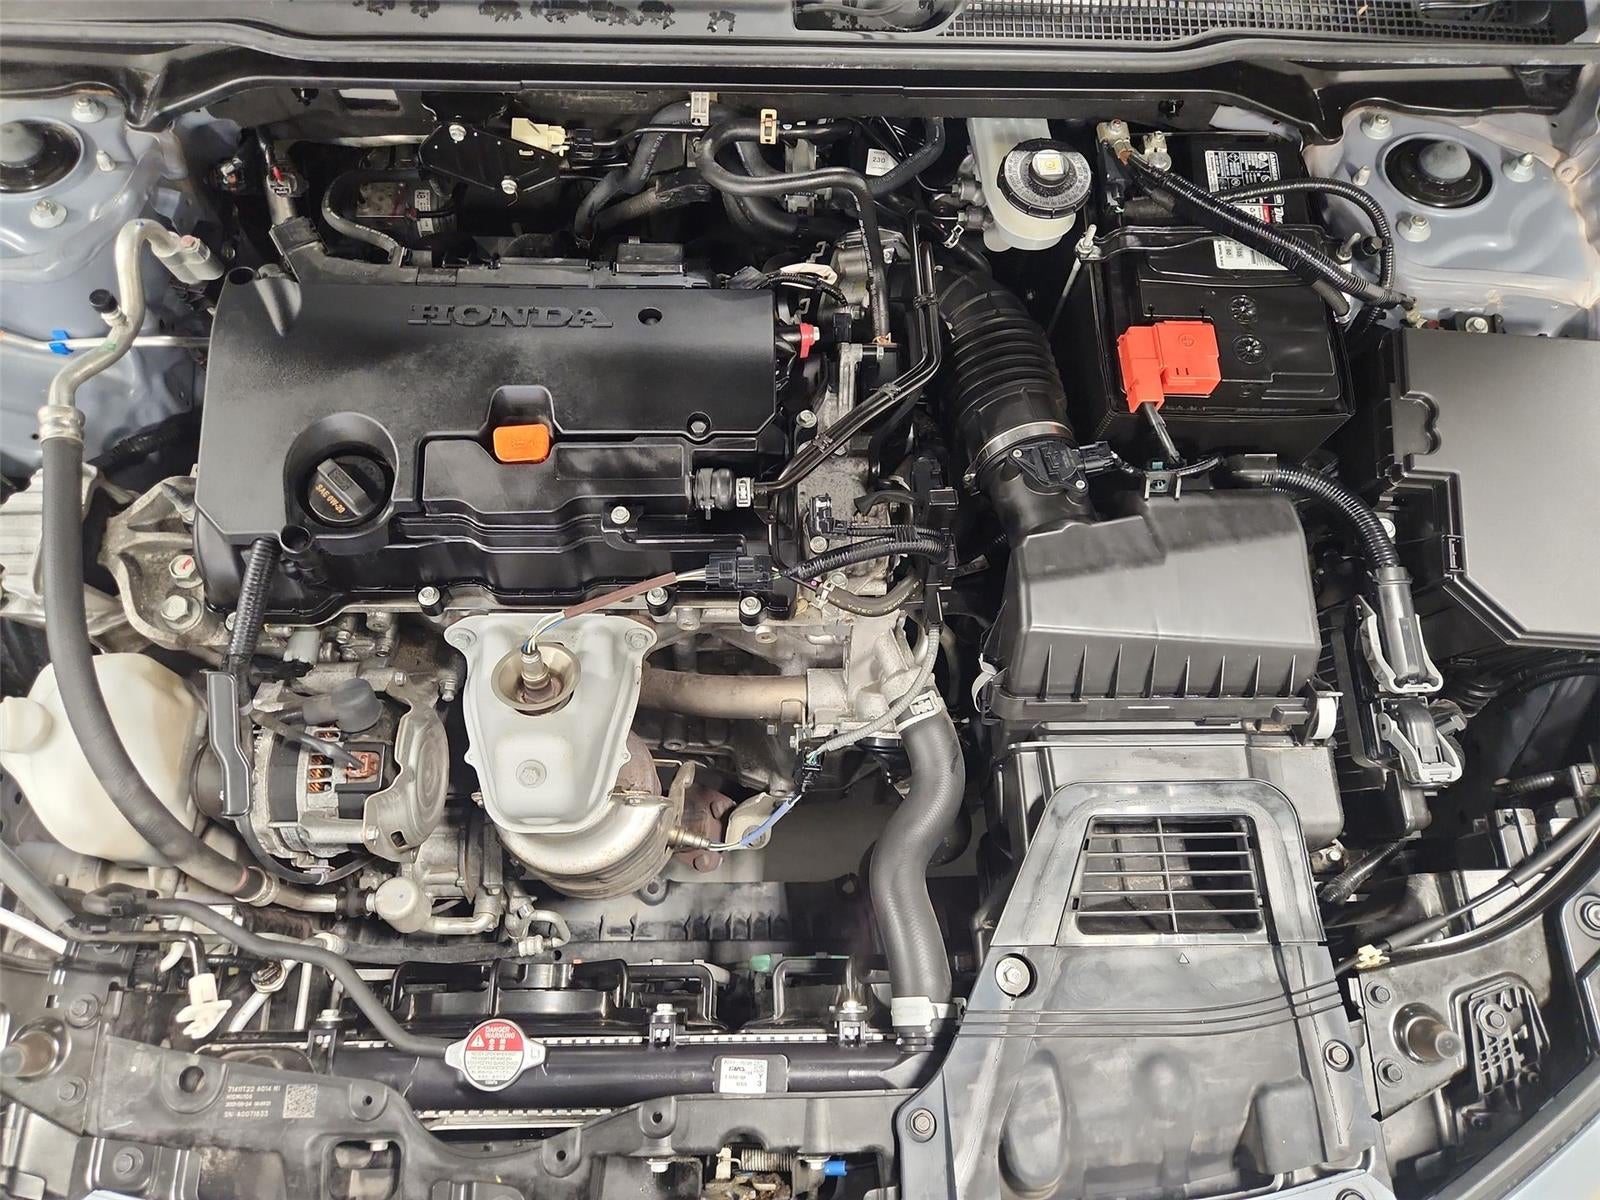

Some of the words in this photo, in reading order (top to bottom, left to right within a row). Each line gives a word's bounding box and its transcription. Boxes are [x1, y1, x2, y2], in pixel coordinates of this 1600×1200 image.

[872, 156, 886, 164] 230
[407, 304, 613, 328] HONDA
[315, 484, 330, 498] SAE
[326, 495, 346, 514] 0W-20
